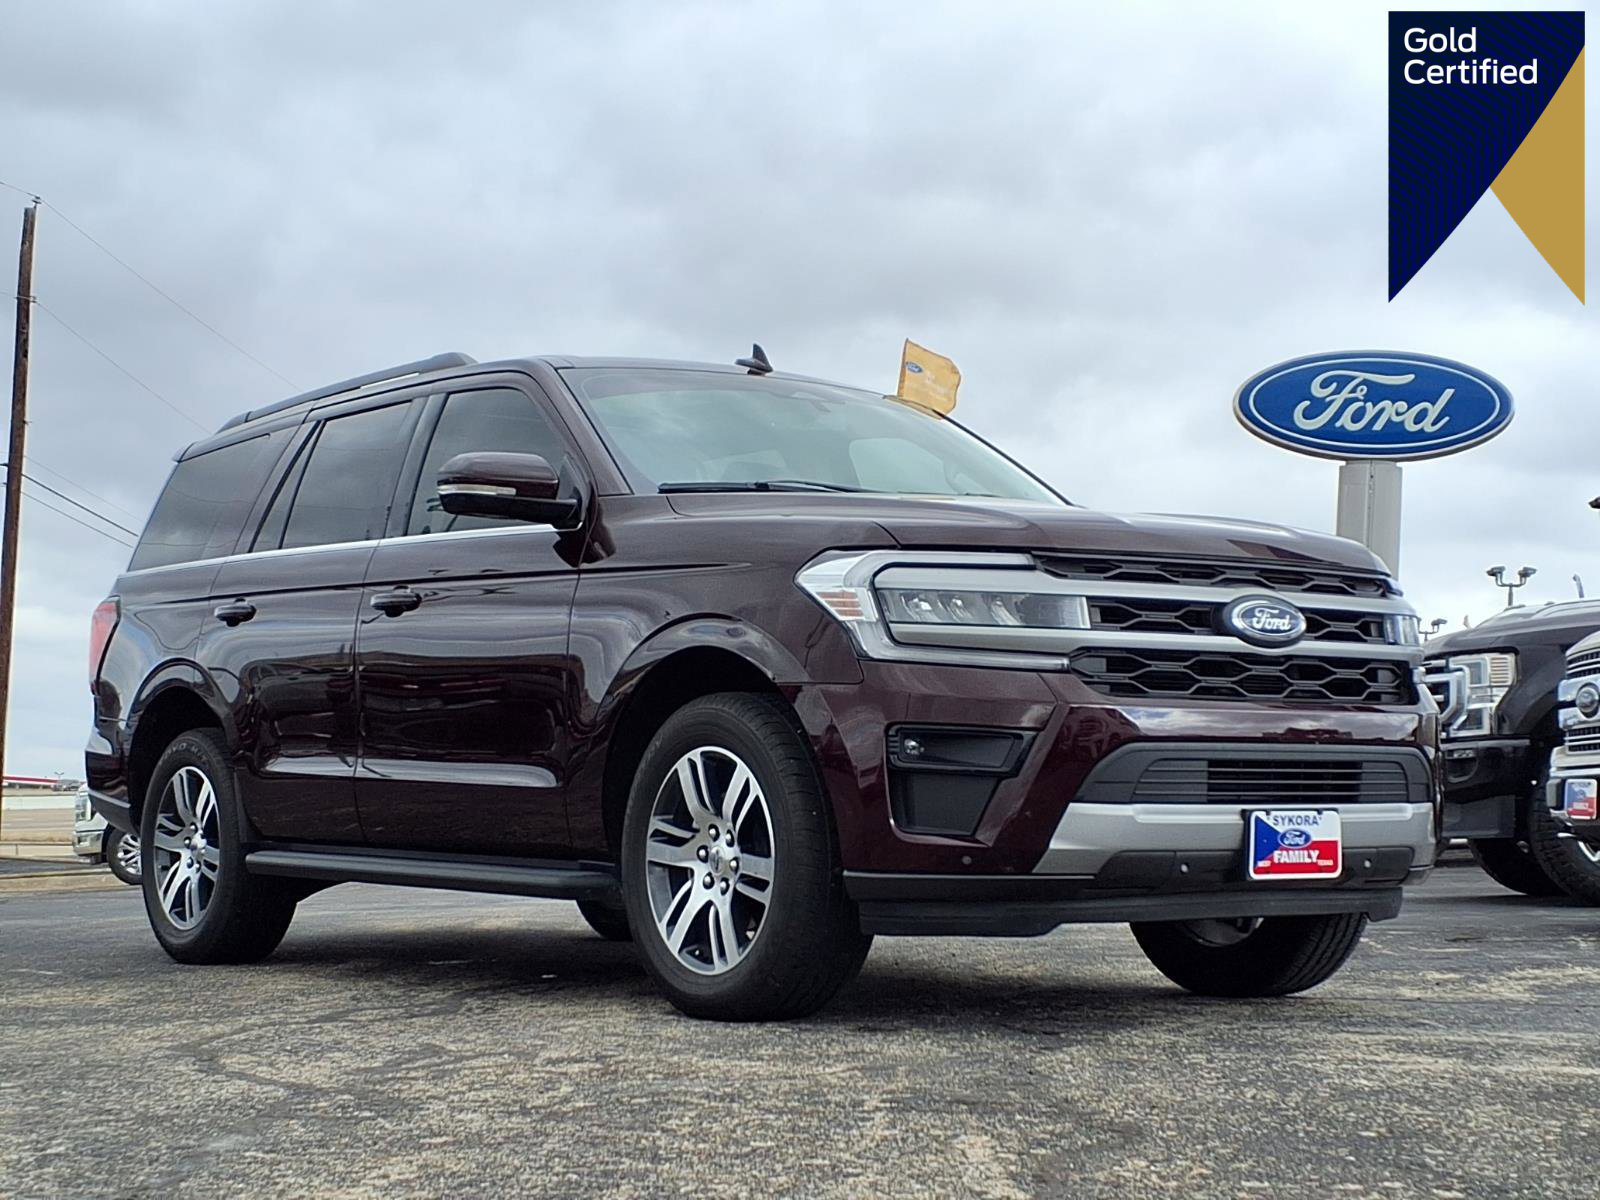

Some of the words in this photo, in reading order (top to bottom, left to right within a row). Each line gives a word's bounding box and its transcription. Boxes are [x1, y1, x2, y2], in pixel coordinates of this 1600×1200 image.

[1293, 370, 1455, 432] Ford
[1252, 607, 1291, 631] Ford
[1273, 815, 1319, 826] SYKORA
[1273, 849, 1320, 863] FAMILY
